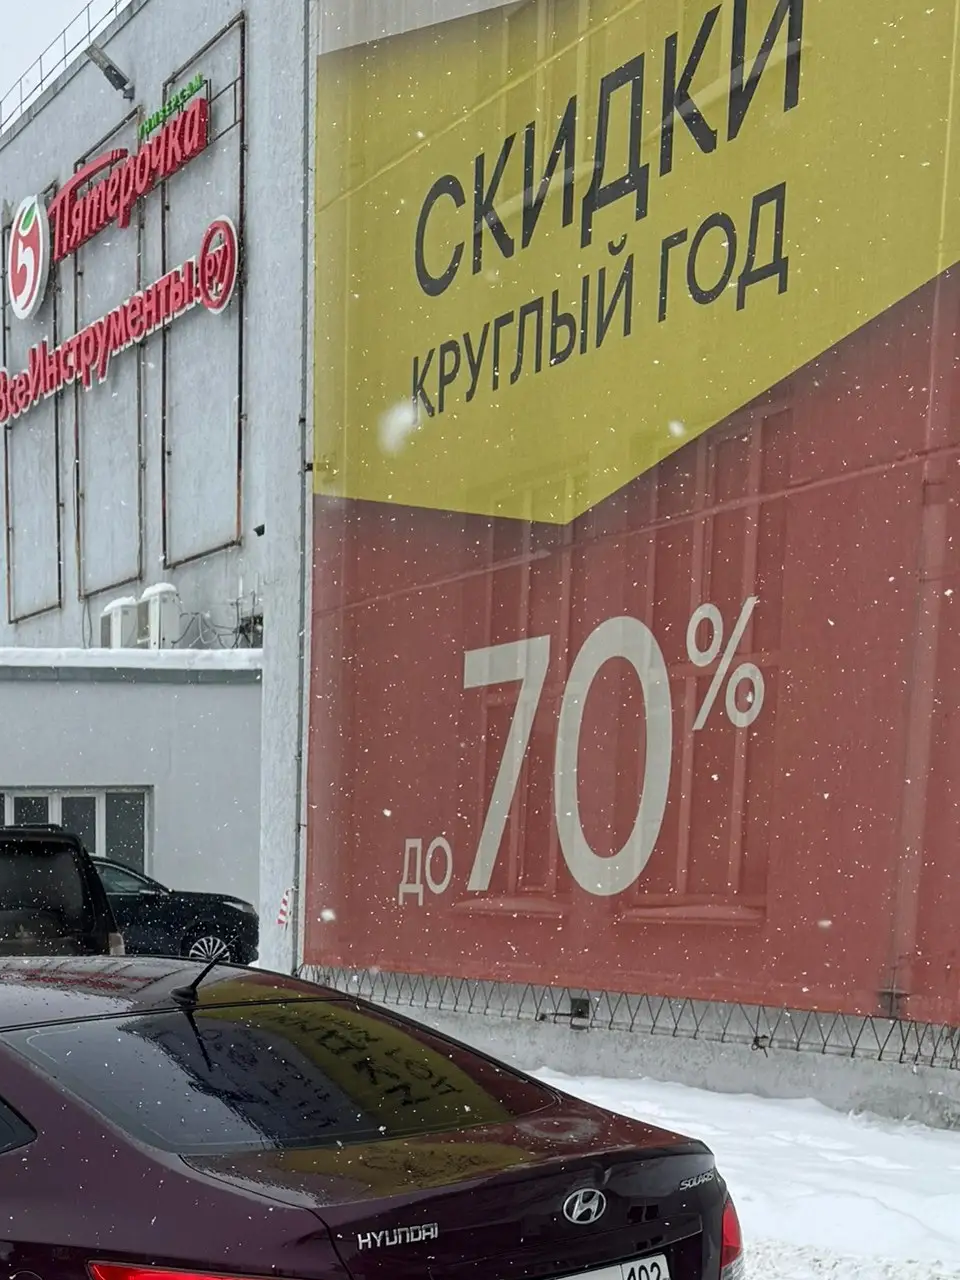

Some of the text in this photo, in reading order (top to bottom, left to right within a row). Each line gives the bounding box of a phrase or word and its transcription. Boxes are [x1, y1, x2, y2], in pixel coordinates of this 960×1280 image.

[414, 0, 805, 298] СКИДКИ
[411, 181, 789, 426] КРУГЛЫЙ ГОД
[357, 1222, 439, 1250] HYUNDAI
